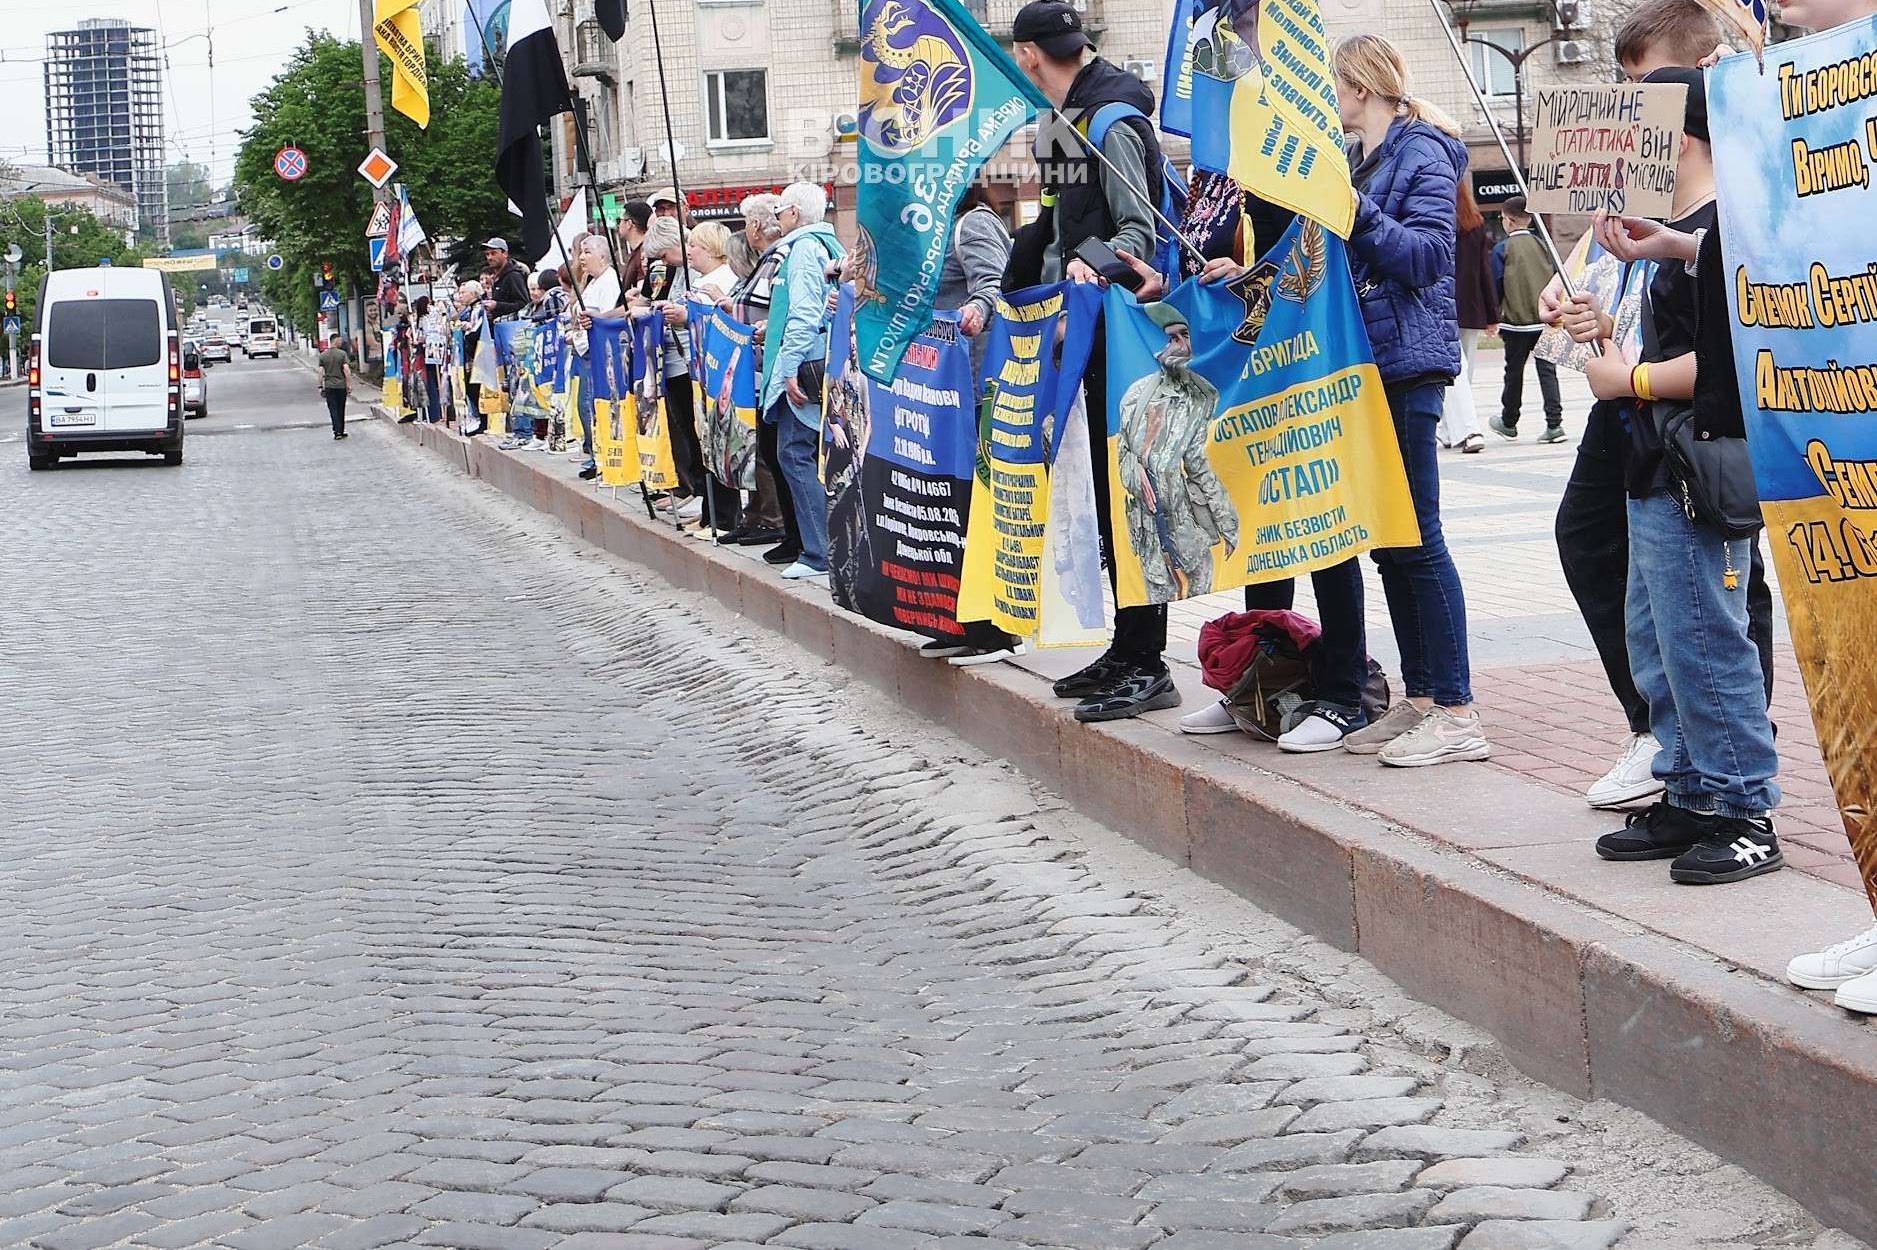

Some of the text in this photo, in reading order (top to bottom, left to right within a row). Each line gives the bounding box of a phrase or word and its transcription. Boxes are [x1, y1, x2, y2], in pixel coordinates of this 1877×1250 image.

[1270, 39, 1320, 92] Зниклі
[1270, 75, 1328, 132] значить
[1618, 90, 1645, 122] НЕ
[1529, 162, 1567, 193] НАШЕ
[1615, 157, 1625, 190] 8
[686, 183, 783, 207] АПТЕ
[1568, 188, 1626, 215] ПОШУКУ
[1255, 505, 1347, 546] ЗНИК БЕЗВІСТИ
[1246, 524, 1368, 575] ДОНЕЦЬКА ОБЛАСТЬ
